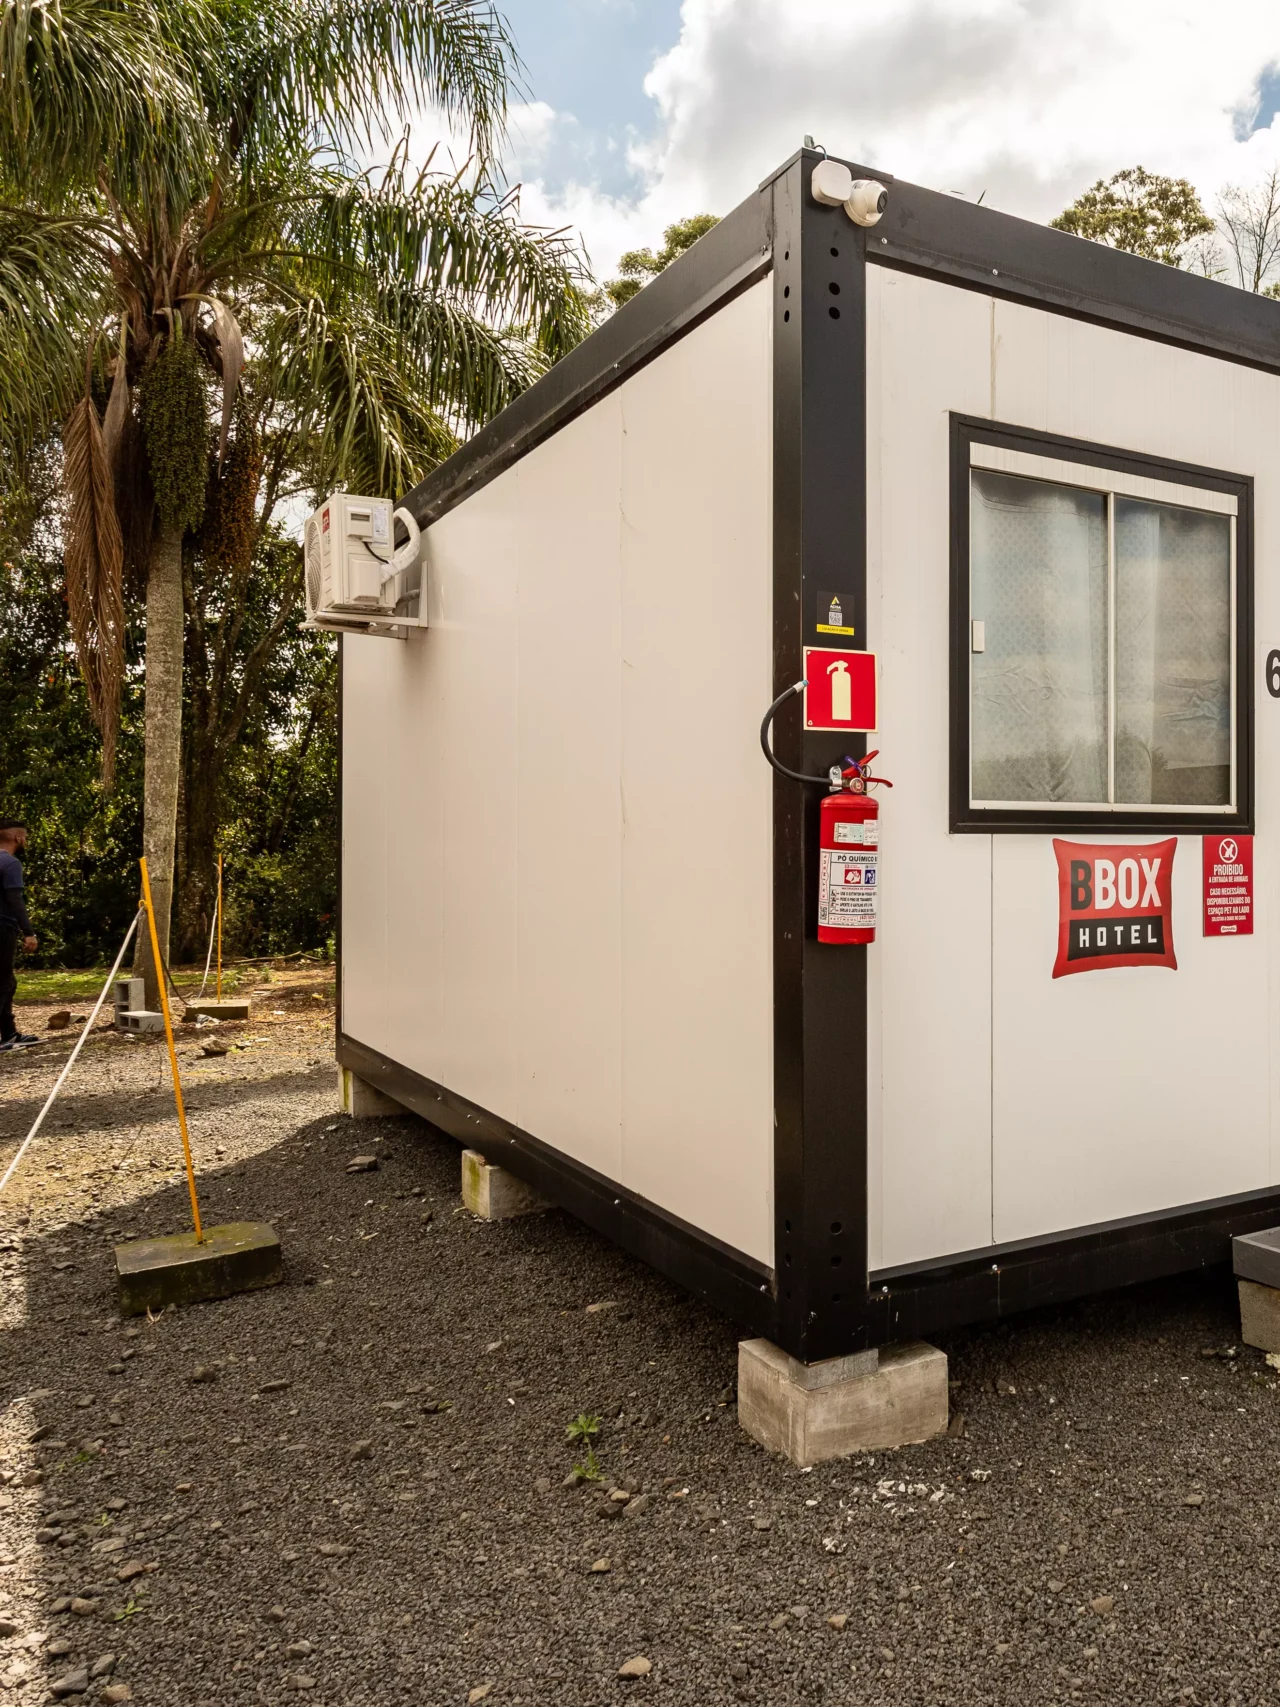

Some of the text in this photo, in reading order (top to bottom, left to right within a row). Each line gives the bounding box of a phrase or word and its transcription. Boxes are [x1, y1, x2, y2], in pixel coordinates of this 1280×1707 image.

[1214, 864, 1244, 876] PROIBIDO
[1070, 858, 1162, 910] BBOX
[1208, 907, 1223, 916] ESPAÇO
[1079, 924, 1158, 948] HOTEL
